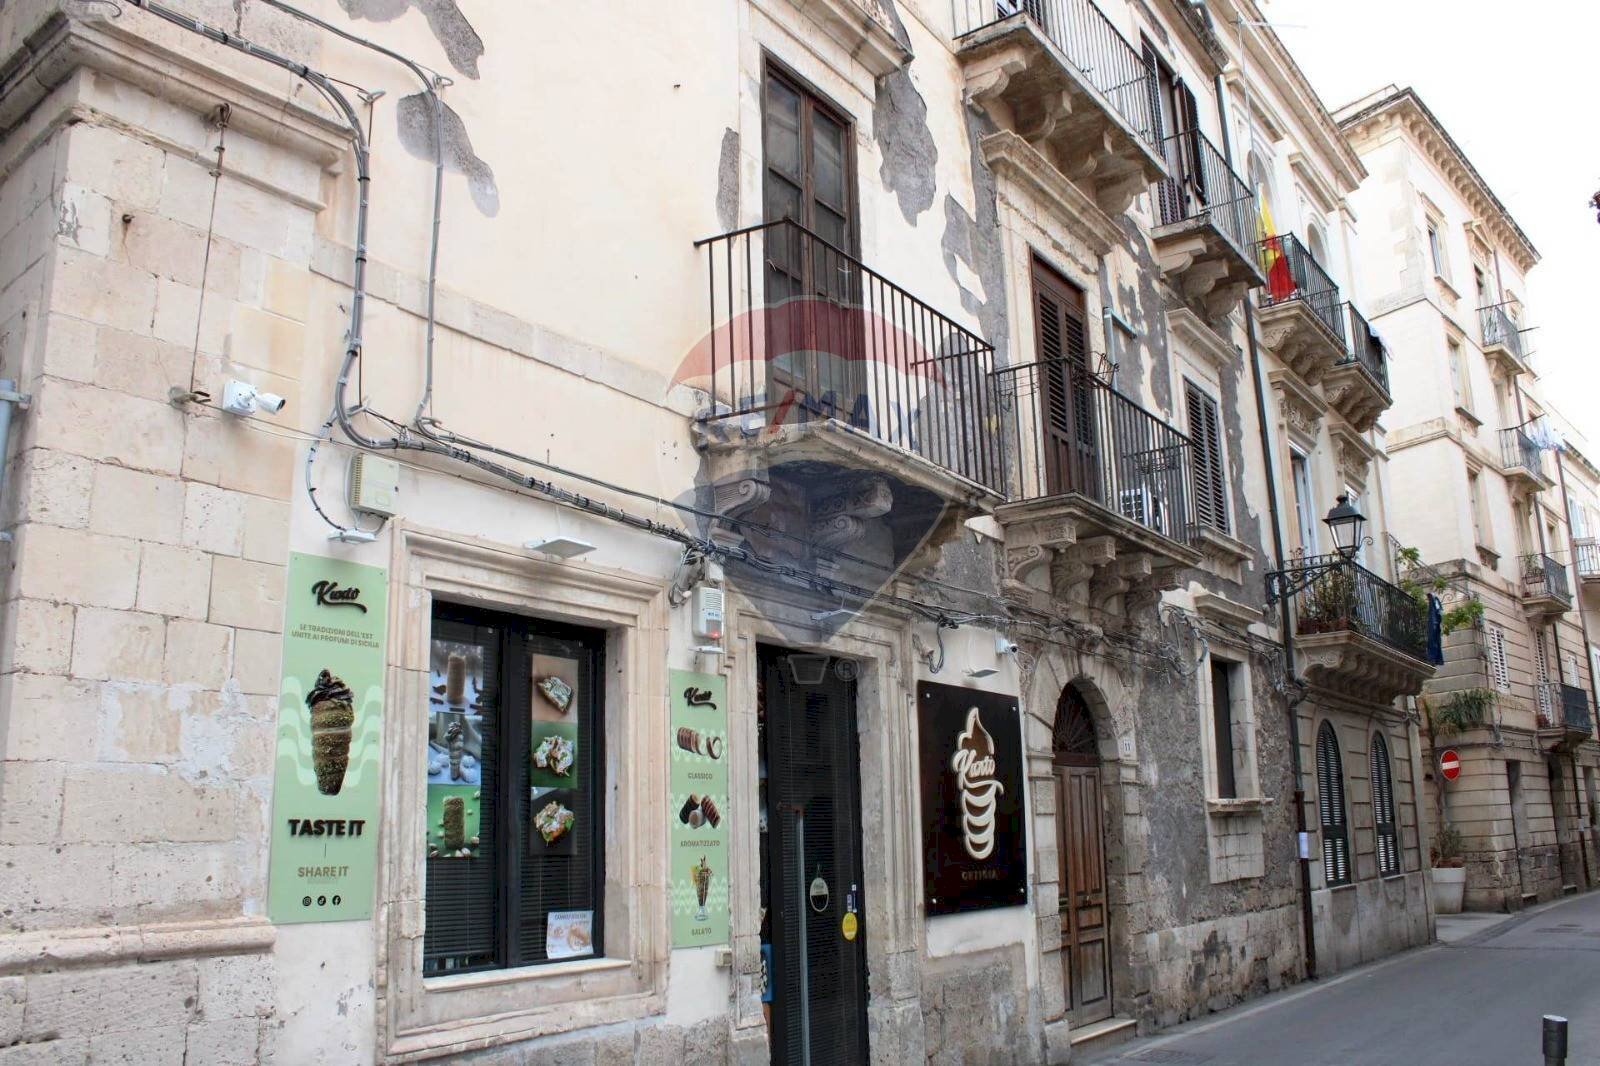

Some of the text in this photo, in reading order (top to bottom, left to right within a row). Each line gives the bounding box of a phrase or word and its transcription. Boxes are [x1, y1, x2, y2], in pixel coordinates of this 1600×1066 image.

[299, 623, 374, 639] LE TRADIZIONI DELL'EST
[291, 630, 311, 639] UNITE
[311, 633, 320, 641] AI
[320, 634, 349, 643] PROFUMI
[358, 640, 379, 648] SICILIA
[687, 772, 713, 780] CLASSICO
[288, 819, 365, 836] TASTE IT
[680, 839, 720, 847] AROMATIZZATO
[297, 866, 349, 877] SHARE IT
[691, 927, 712, 937] SALATO
